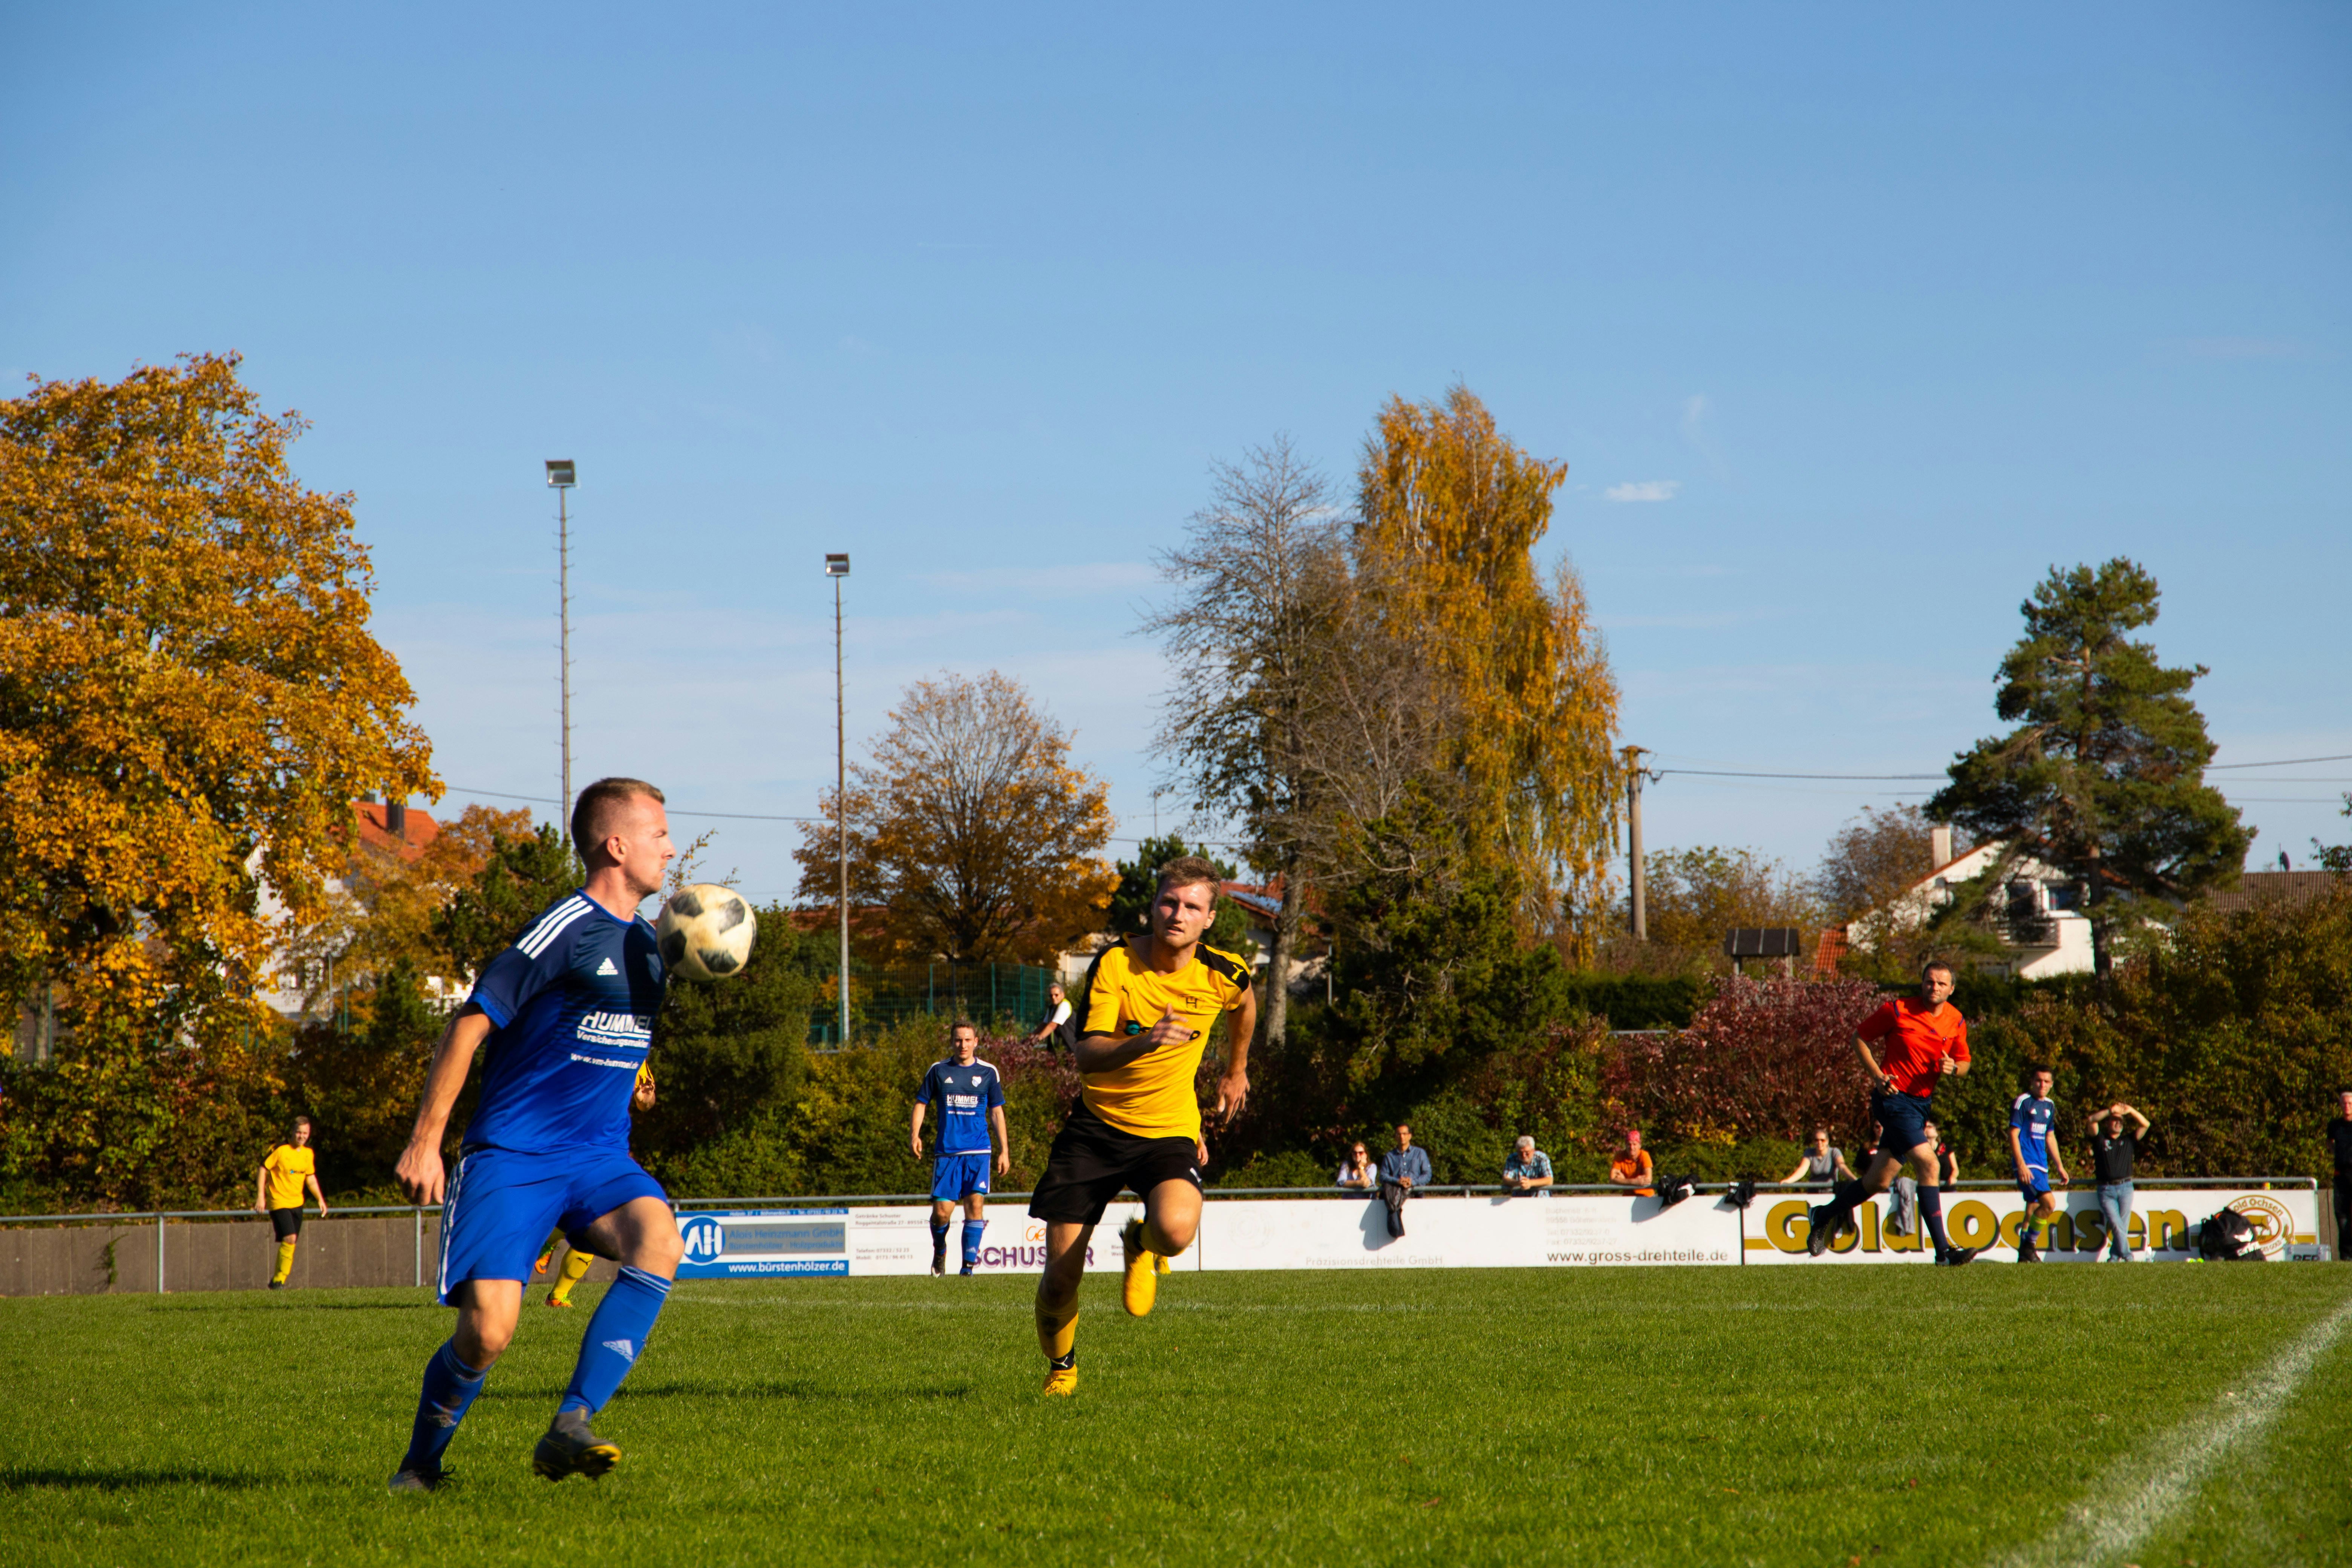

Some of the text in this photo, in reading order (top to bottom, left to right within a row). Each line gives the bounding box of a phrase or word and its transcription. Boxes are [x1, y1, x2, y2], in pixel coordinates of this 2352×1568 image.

[947, 1094, 978, 1103] HUMMEL
[2249, 1198, 2284, 1217] Ochsen
[812, 1227, 843, 1238] GmbH
[1409, 1255, 1443, 1265] GmbH
[1548, 1248, 1728, 1264] www.gross-drehteile.de
[729, 1260, 845, 1273] www.bürstenhölzer.de
